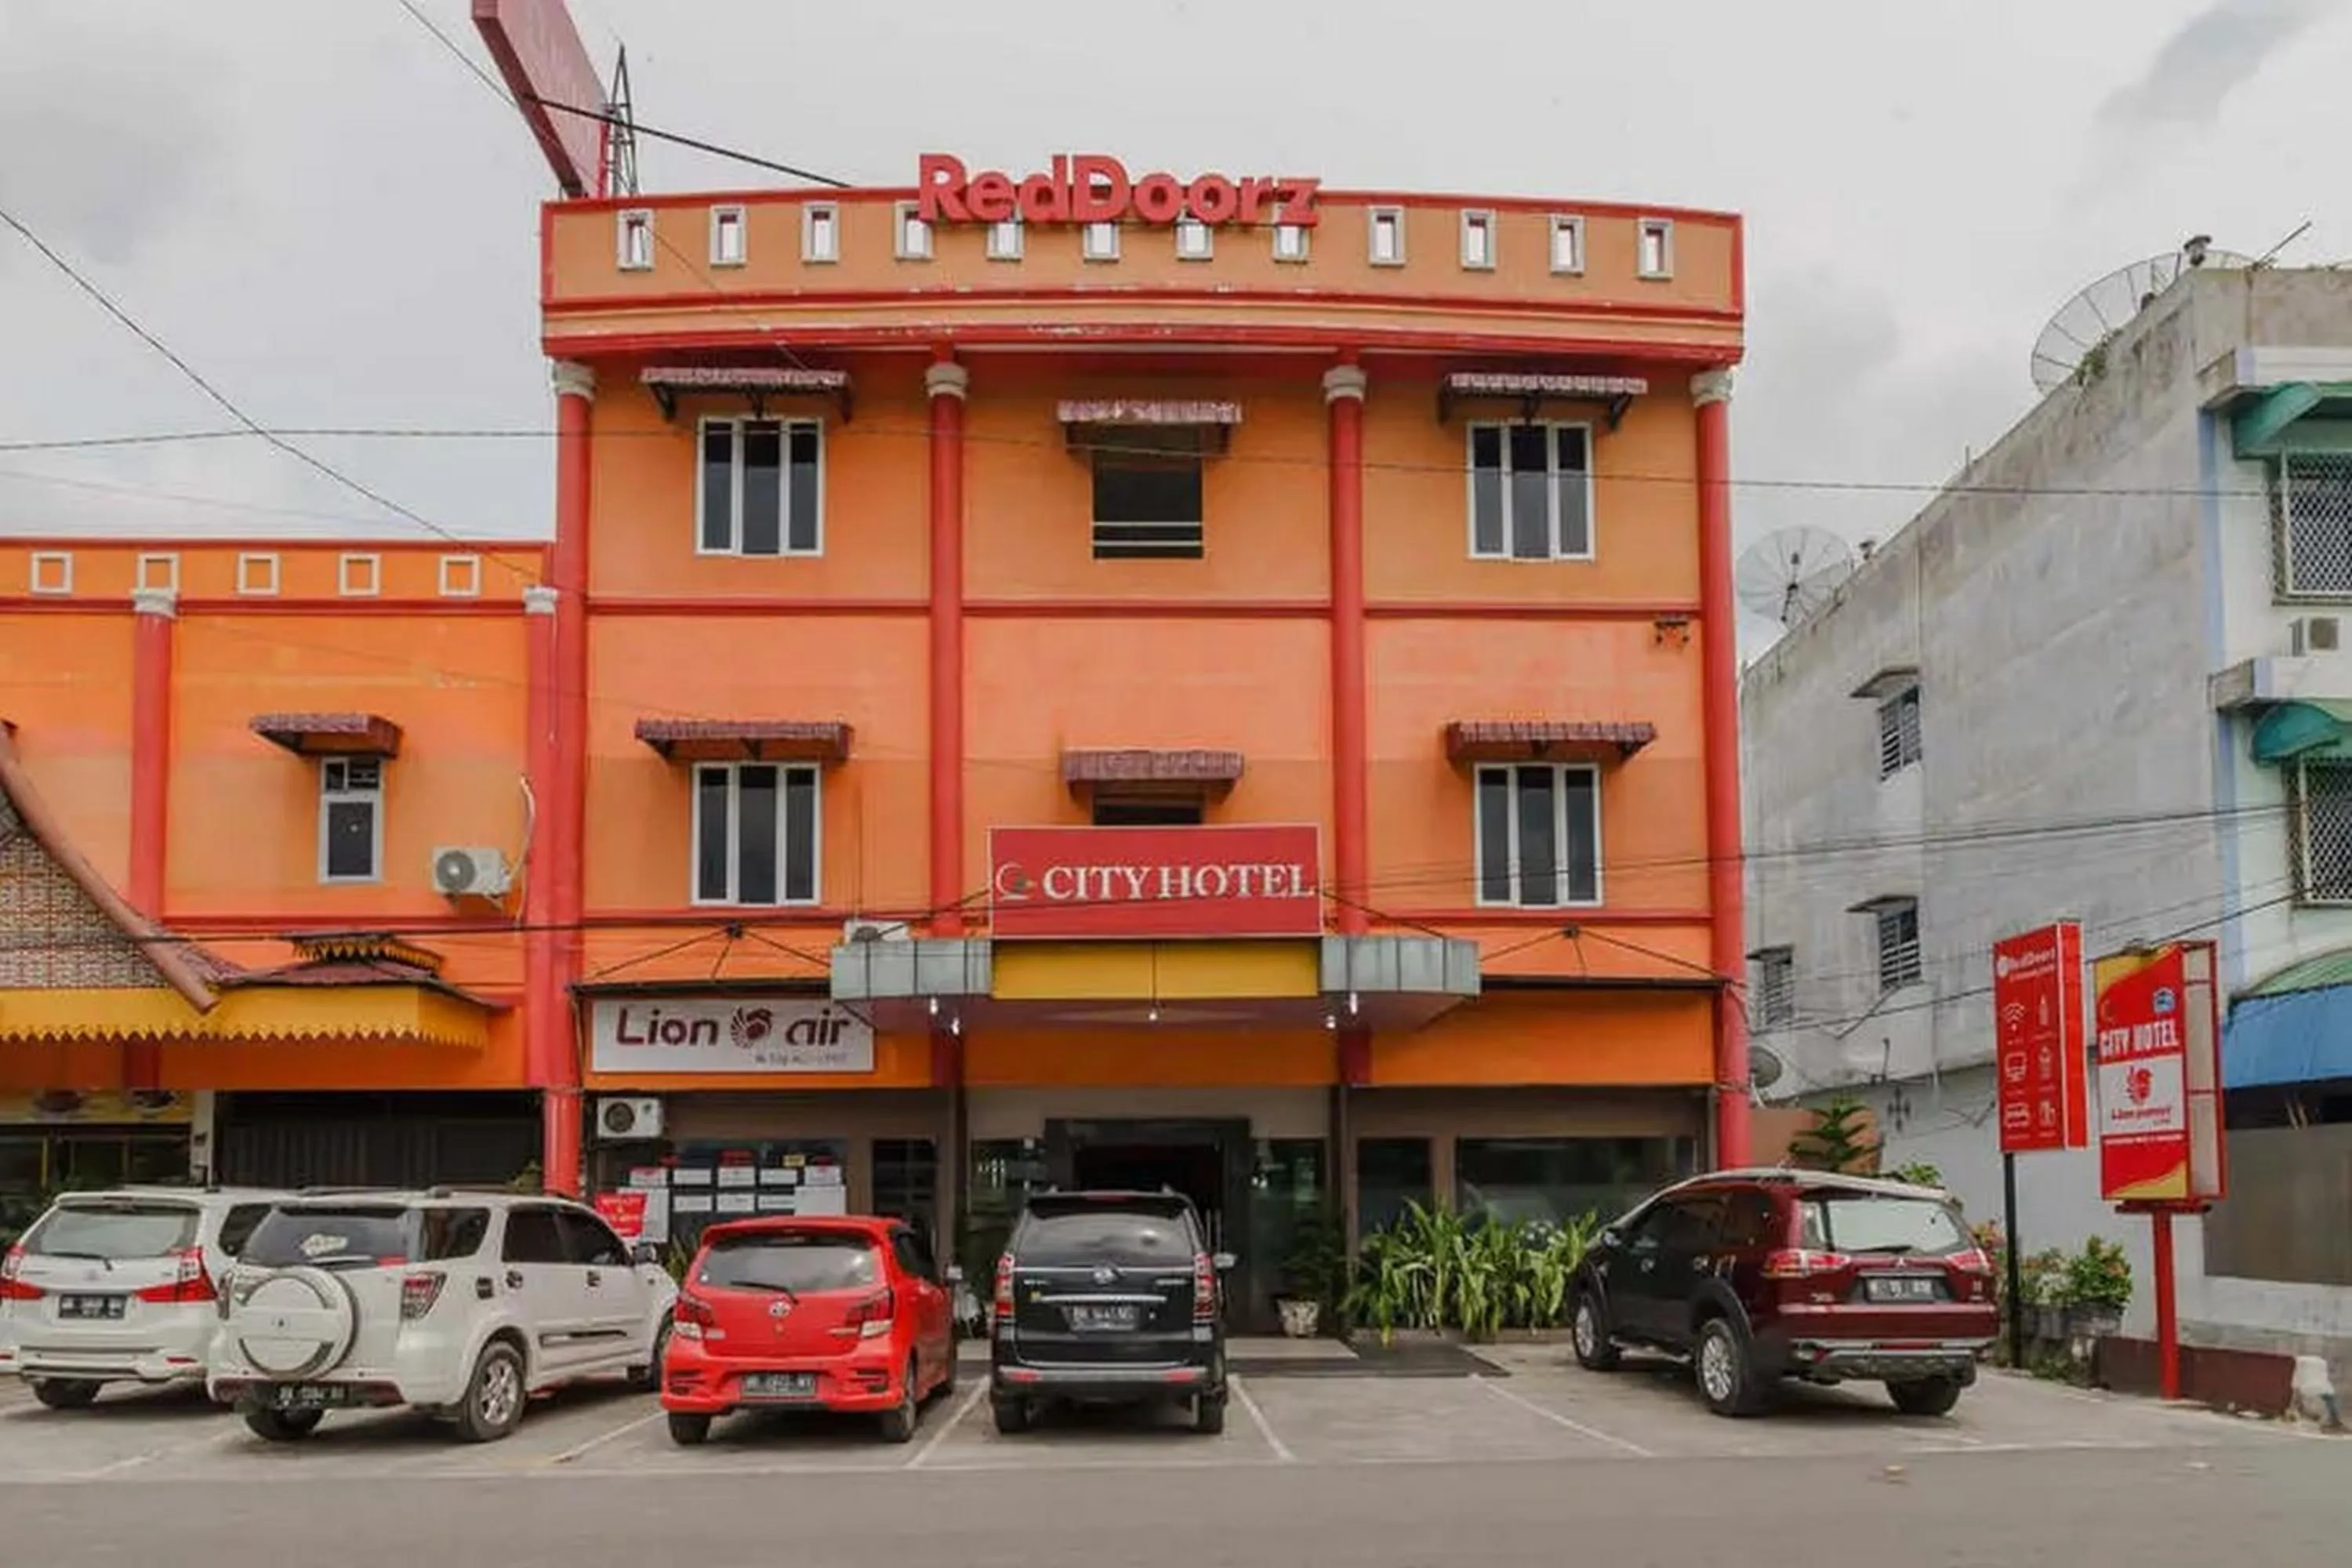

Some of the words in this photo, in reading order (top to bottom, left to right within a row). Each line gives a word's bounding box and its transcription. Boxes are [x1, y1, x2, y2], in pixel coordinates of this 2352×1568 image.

[918, 153, 1322, 226] RedDoorz
[1041, 866, 1152, 901] CITY
[1157, 863, 1316, 899] HOTEL
[615, 1007, 720, 1047] Lion
[784, 1007, 851, 1047] air
[2100, 1027, 2131, 1057] CITY
[2132, 1018, 2180, 1051] HOTEL
